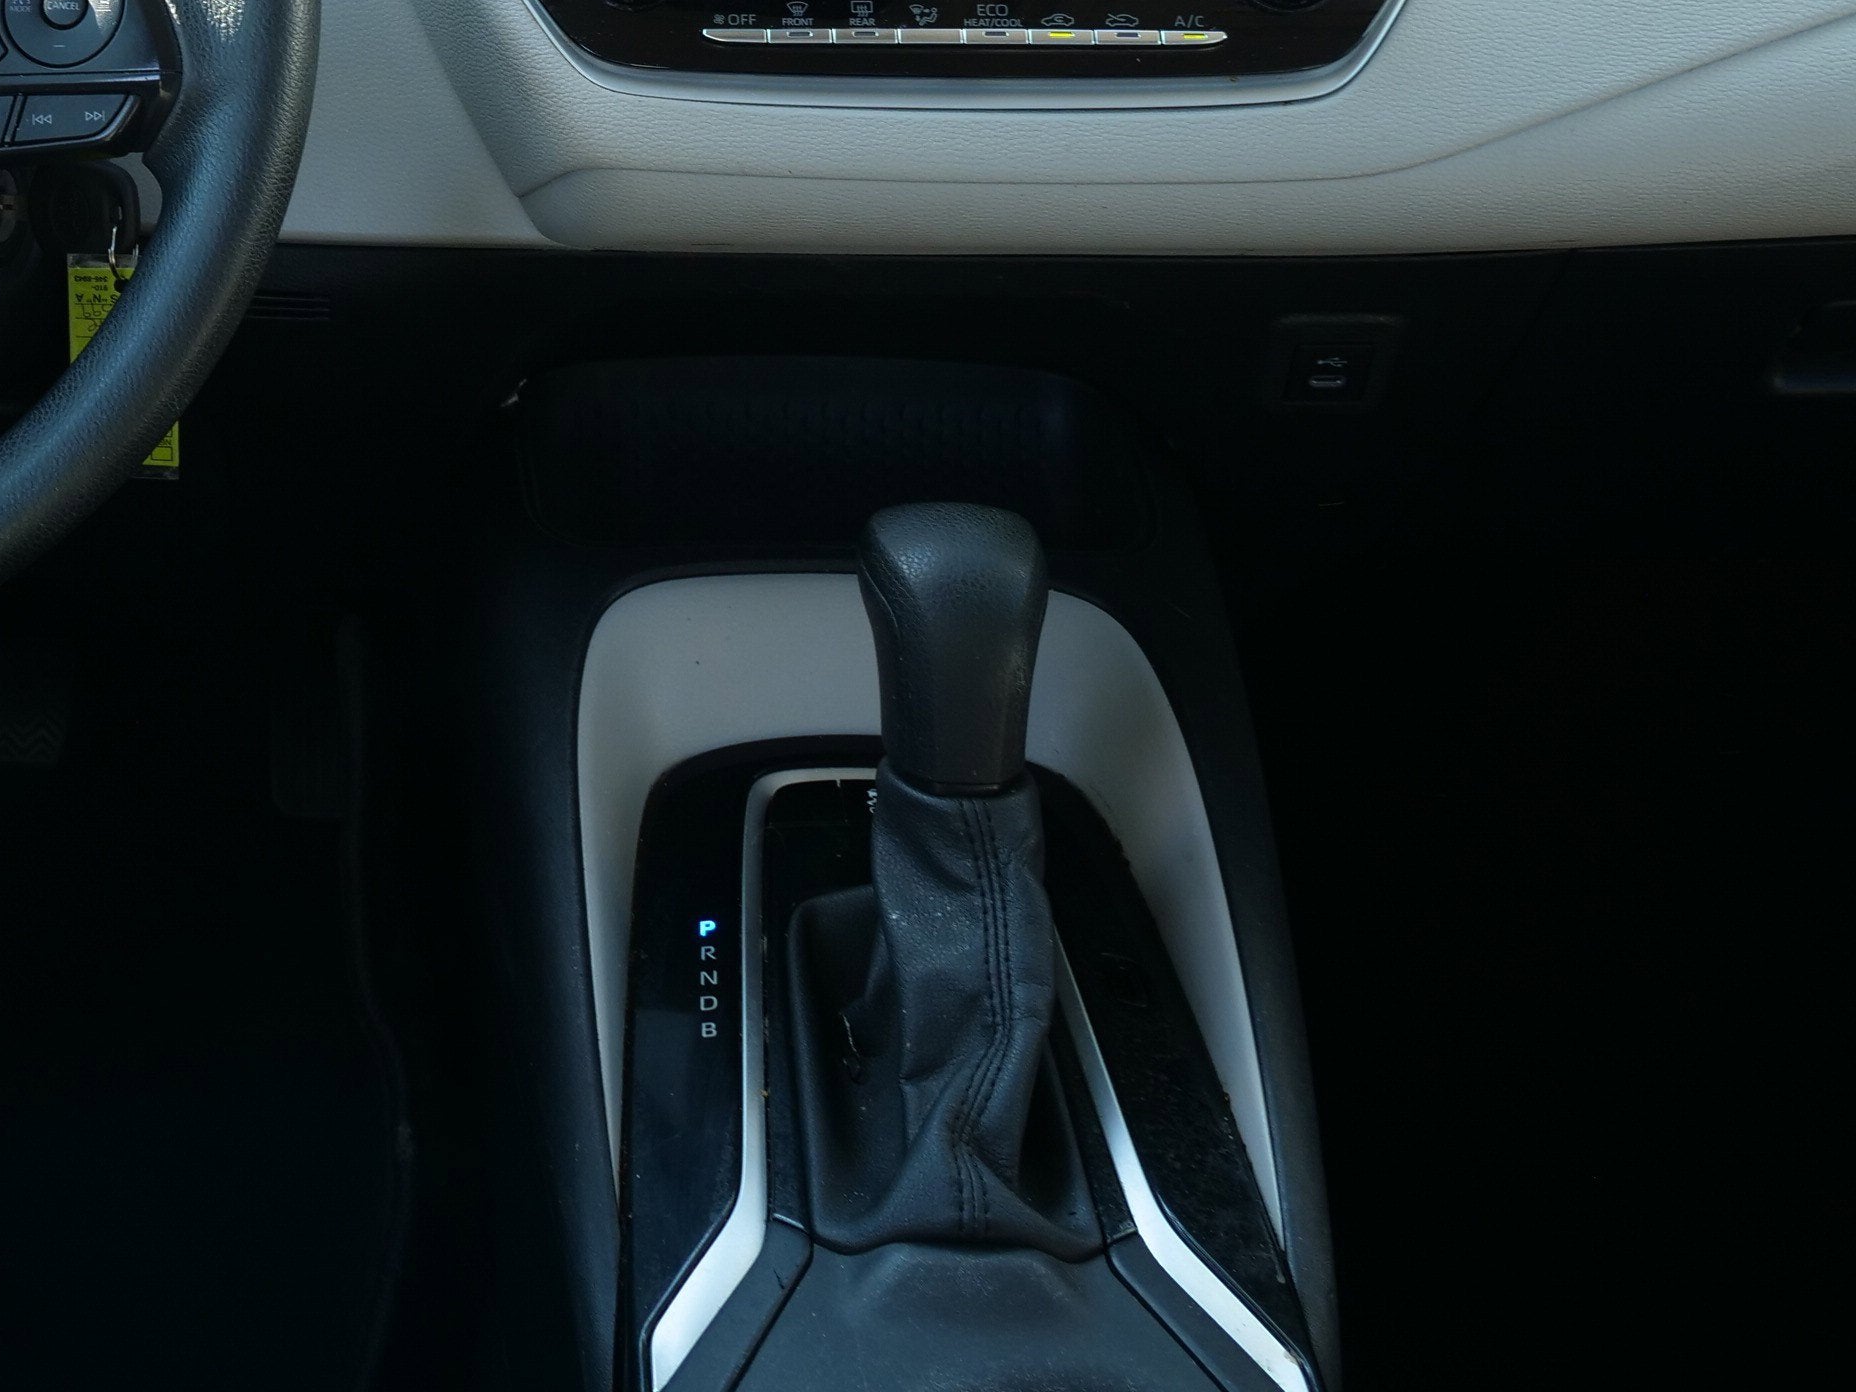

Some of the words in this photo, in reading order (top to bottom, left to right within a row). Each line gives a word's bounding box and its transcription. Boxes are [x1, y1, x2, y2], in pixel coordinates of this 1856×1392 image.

[46, 0, 80, 11] CANCEL
[976, 4, 1009, 17] ECO
[727, 13, 757, 26] OFF
[781, 17, 814, 27] FRONT
[848, 17, 875, 27] REAR
[964, 18, 1023, 27] HEAT/COOL
[1174, 14, 1205, 28] A/C
[699, 920, 716, 937] P
[700, 945, 717, 961] R
[700, 970, 718, 986] N
[700, 995, 718, 1011] D
[701, 1022, 717, 1038] B
